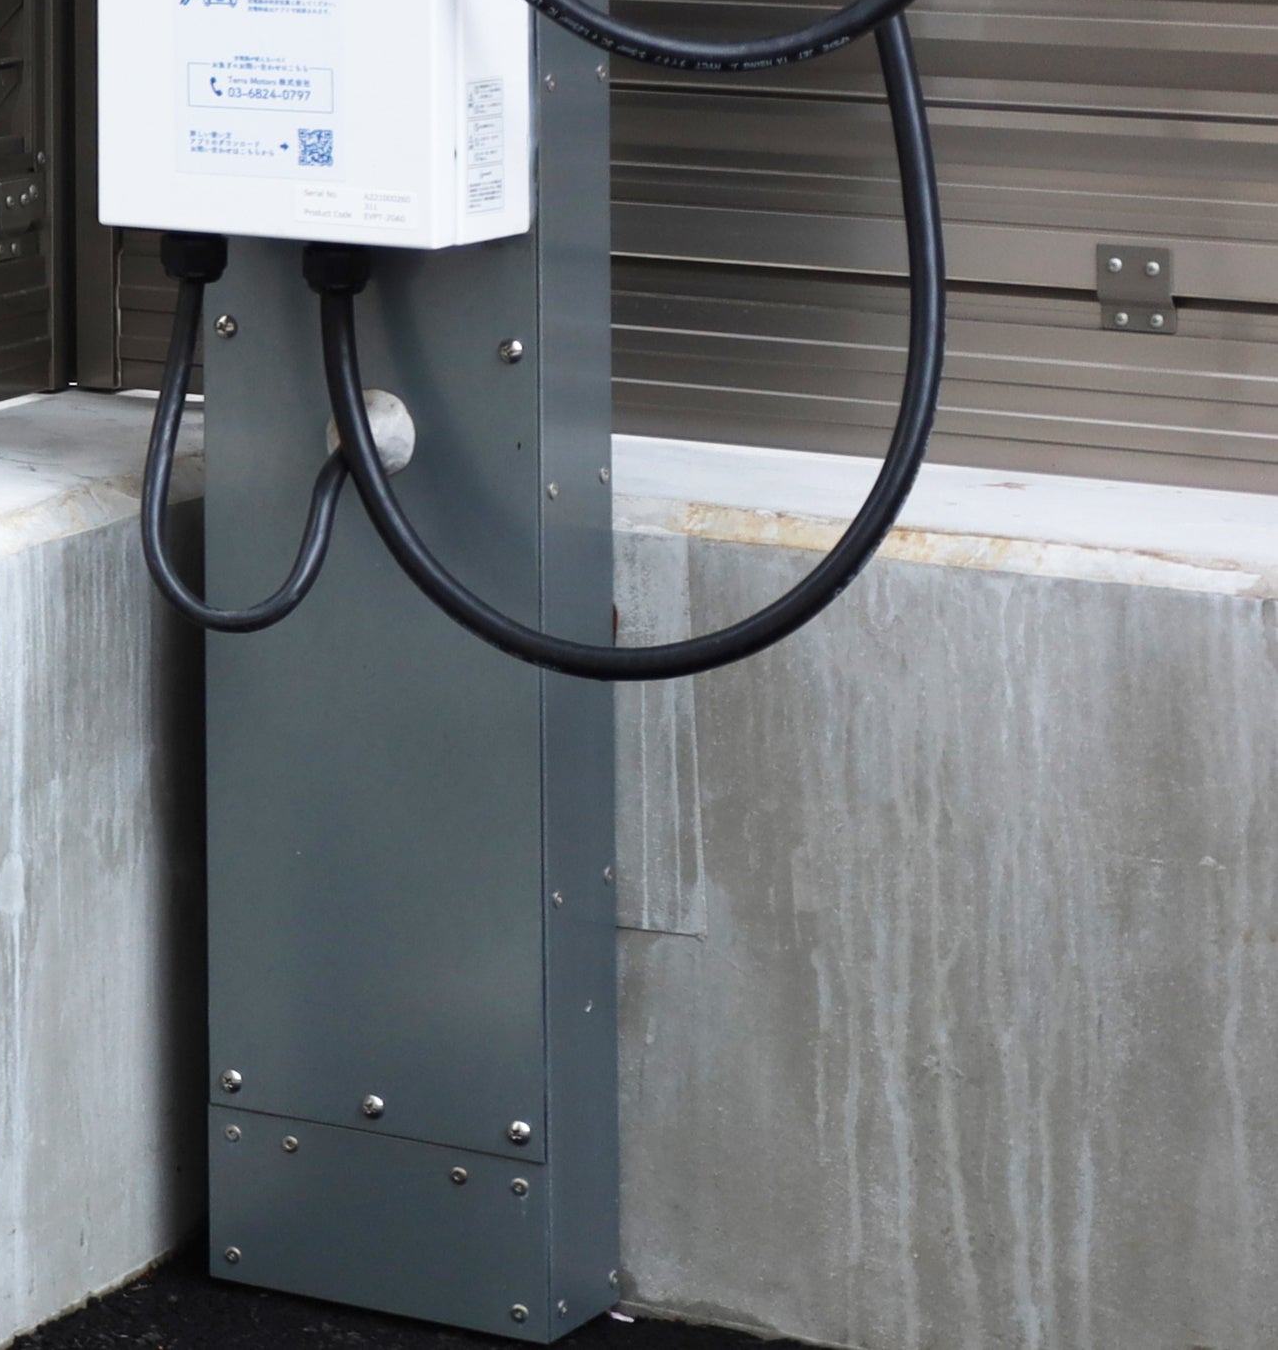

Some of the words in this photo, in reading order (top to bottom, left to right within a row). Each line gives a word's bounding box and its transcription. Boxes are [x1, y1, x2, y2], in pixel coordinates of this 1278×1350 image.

[228, 76, 248, 85] Terra
[250, 77, 276, 87] Motors
[227, 87, 312, 101] 03-6824-0797
